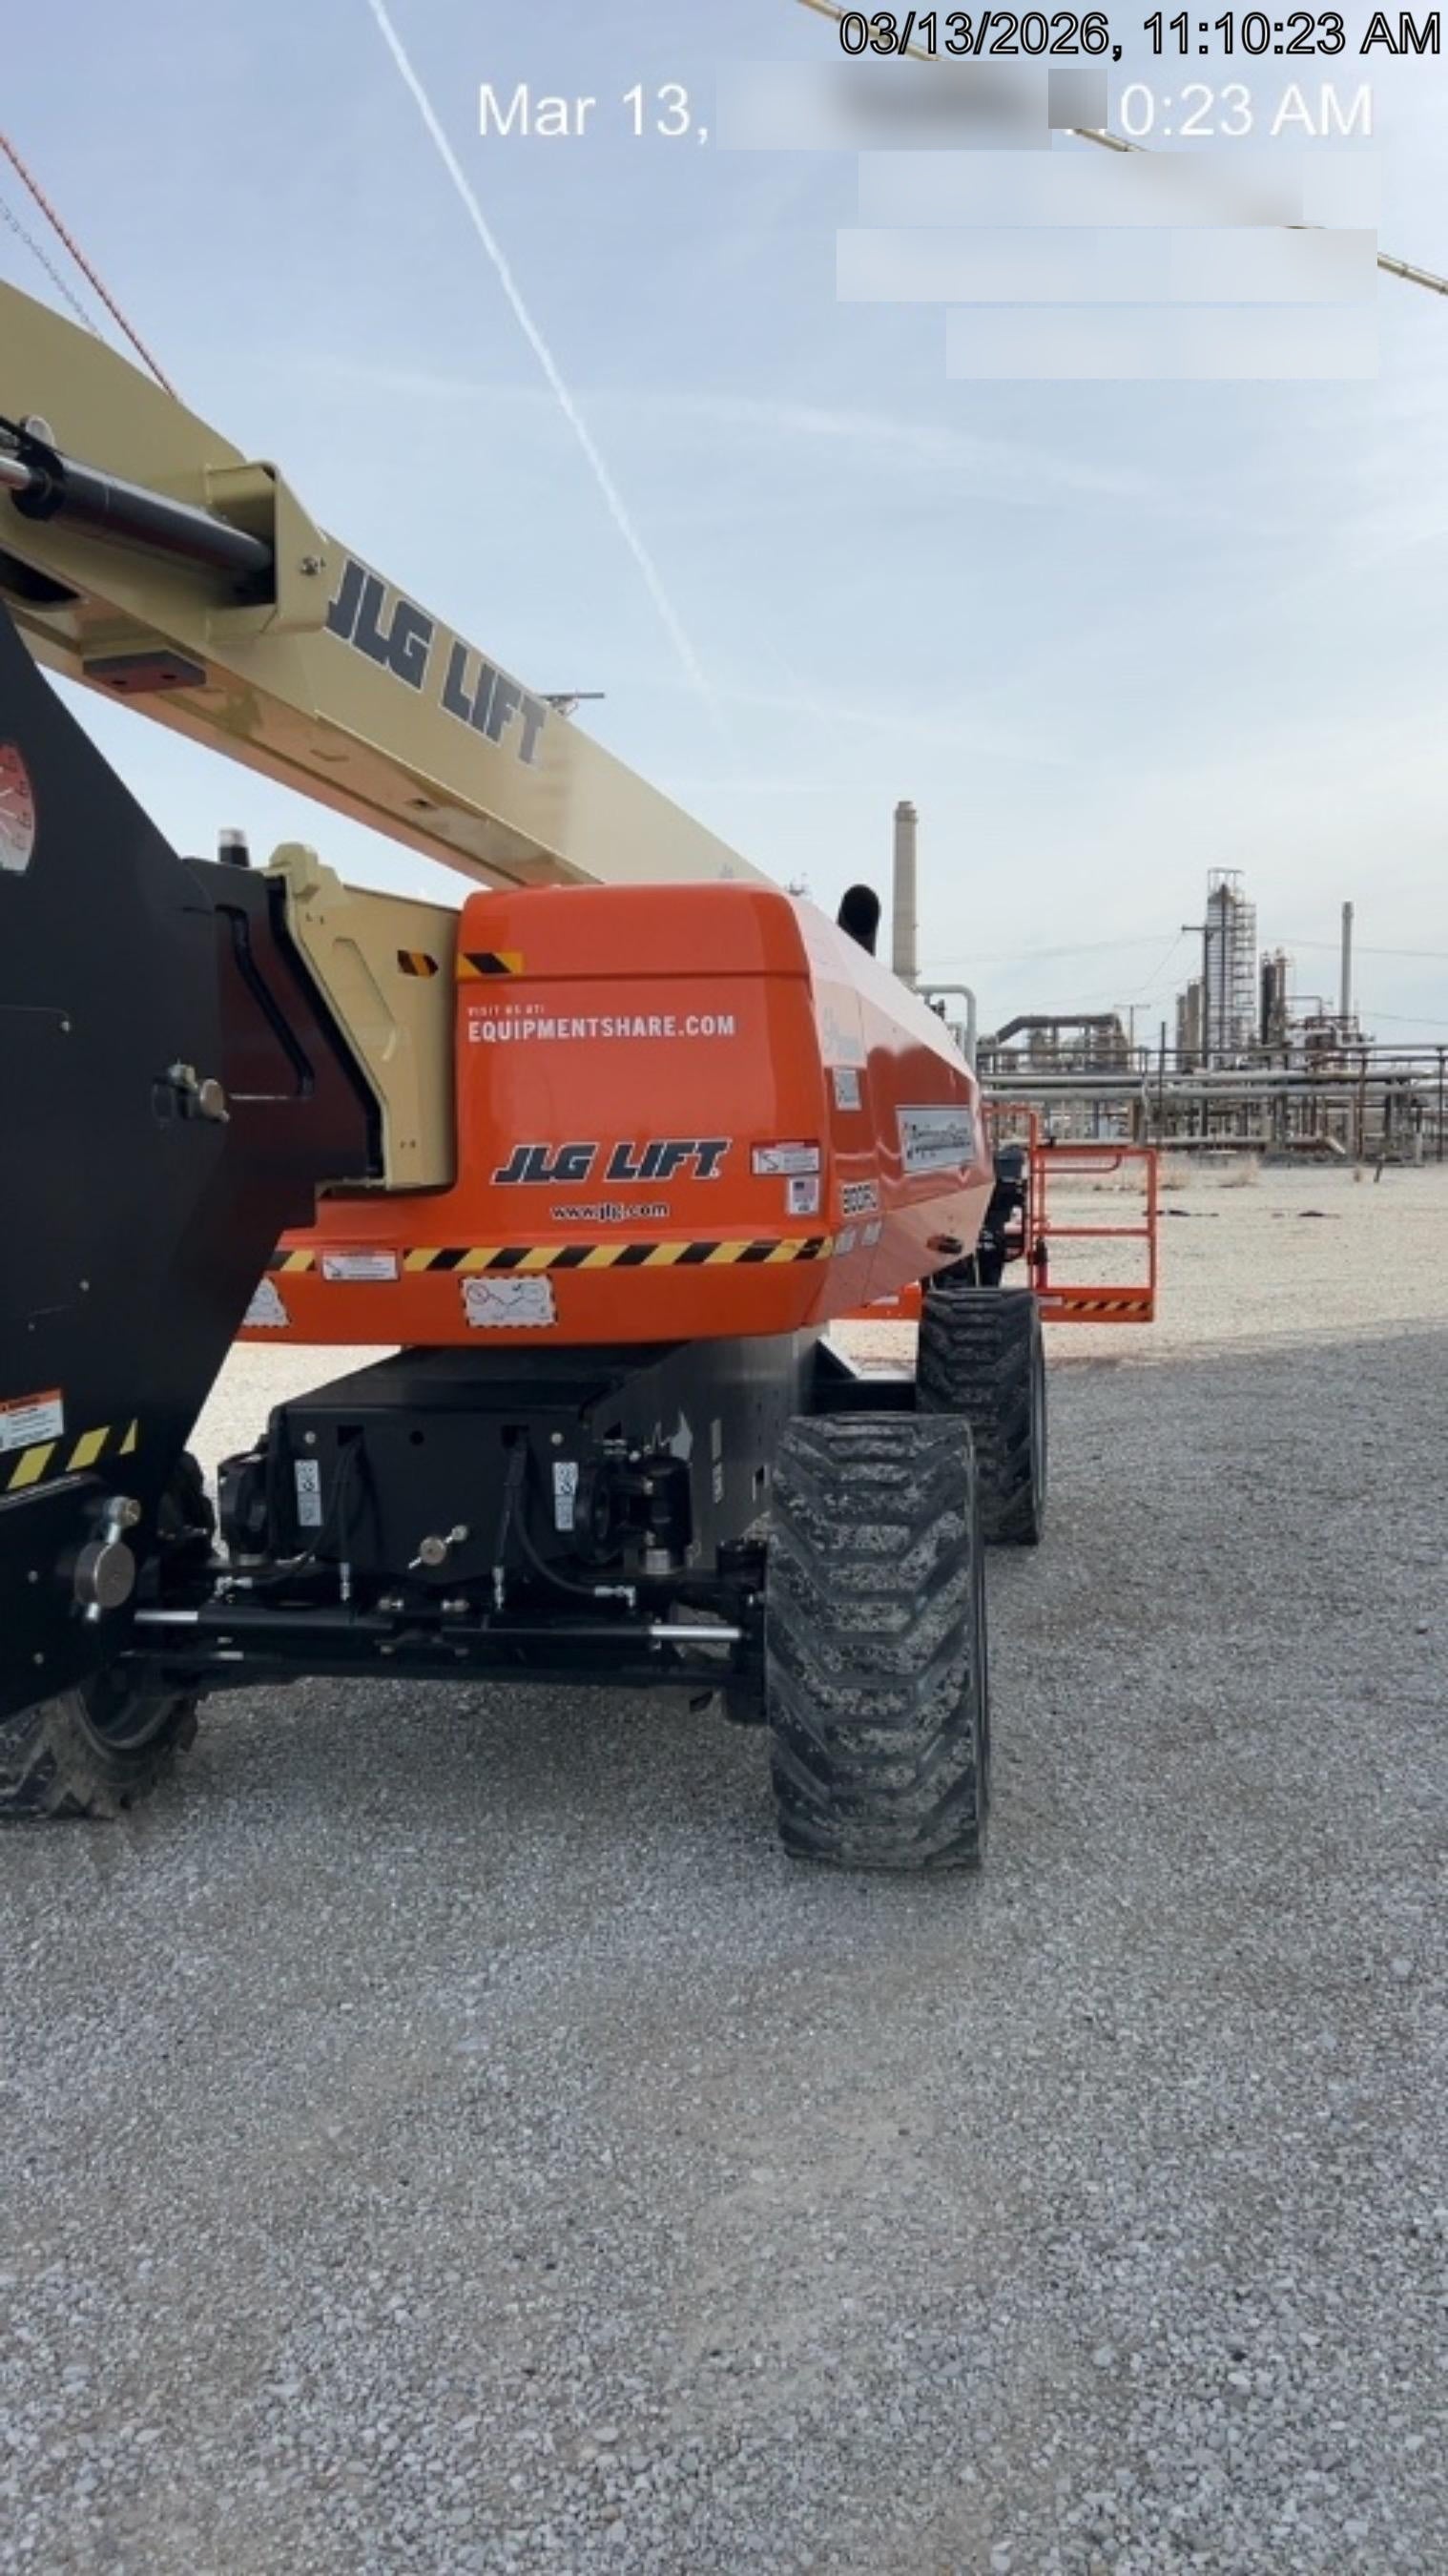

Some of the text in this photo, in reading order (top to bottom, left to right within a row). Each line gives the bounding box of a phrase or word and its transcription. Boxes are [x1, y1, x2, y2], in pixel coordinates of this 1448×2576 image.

[324, 556, 550, 766] JLG LIFT
[467, 1014, 734, 1044] EQUIPMENTSHARE.COM
[490, 1141, 600, 1185] JLG
[603, 1136, 733, 1183] LIFT
[551, 1201, 670, 1222] www.jlg.com
